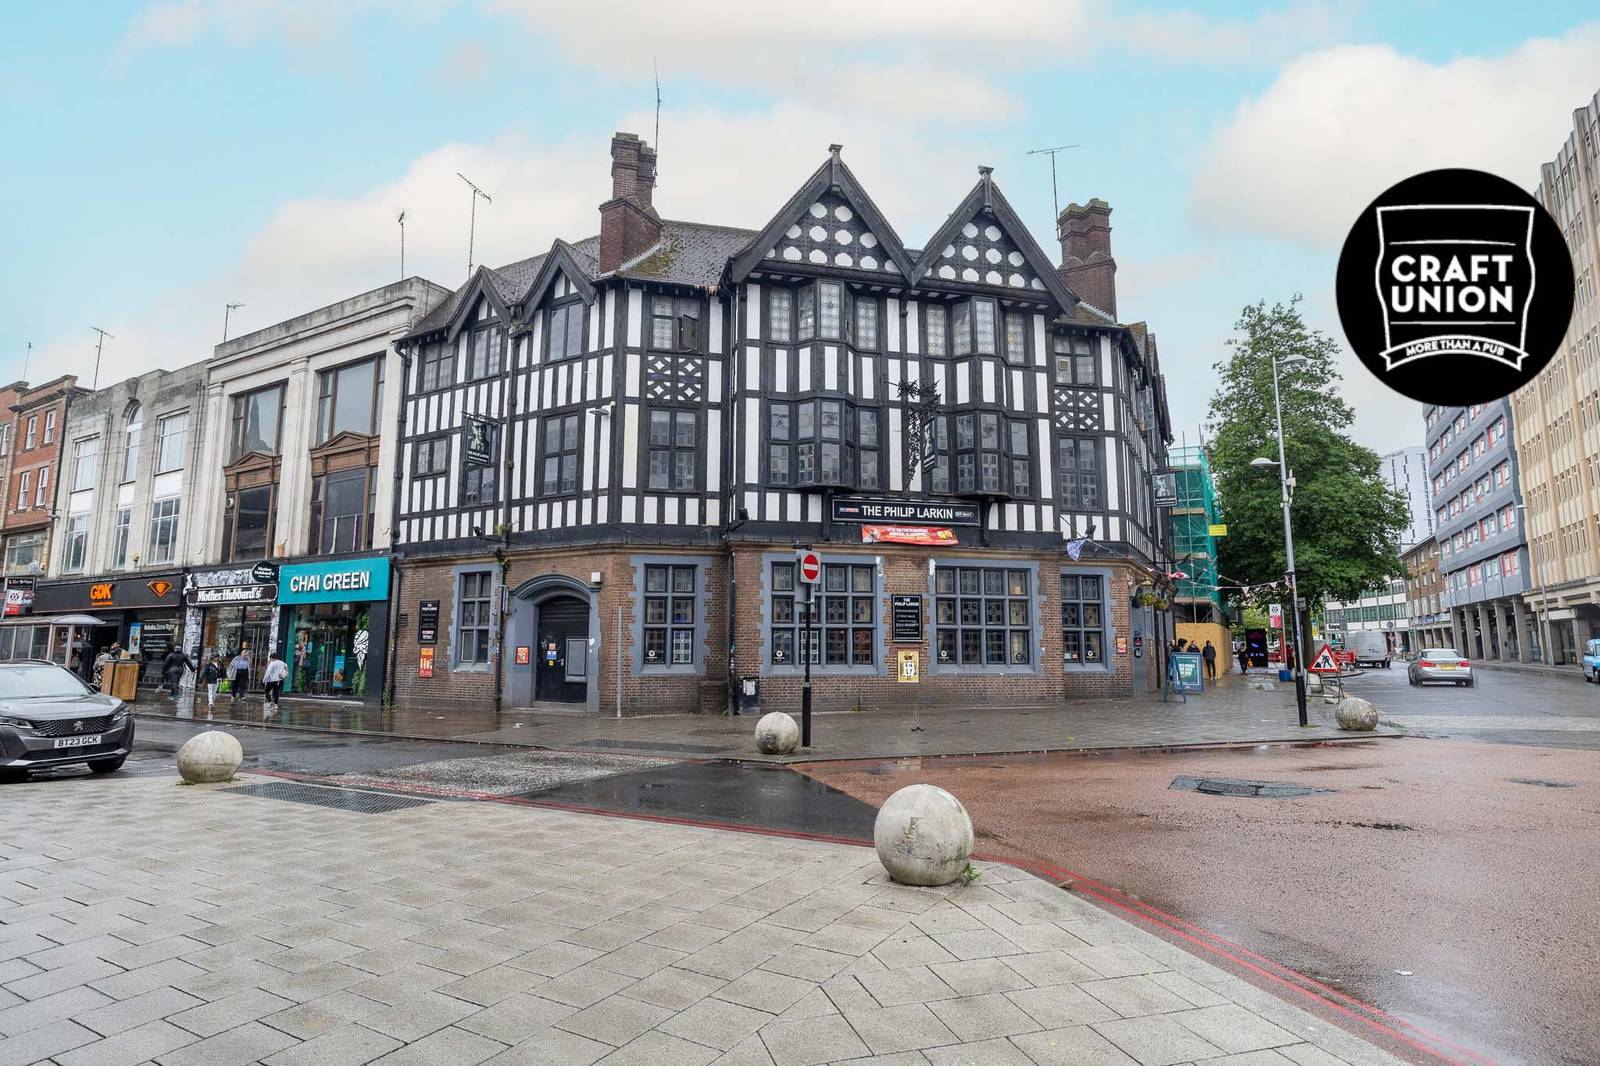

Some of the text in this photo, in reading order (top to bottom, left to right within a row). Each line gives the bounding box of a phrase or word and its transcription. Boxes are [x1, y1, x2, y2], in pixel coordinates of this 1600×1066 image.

[861, 505, 953, 519] THE PHILIP LARKIN
[290, 570, 370, 592] CHAI GREEN
[90, 583, 113, 599] GDK
[197, 586, 264, 602] Mother Hubbard's
[58, 736, 98, 747] BT23 GCK
